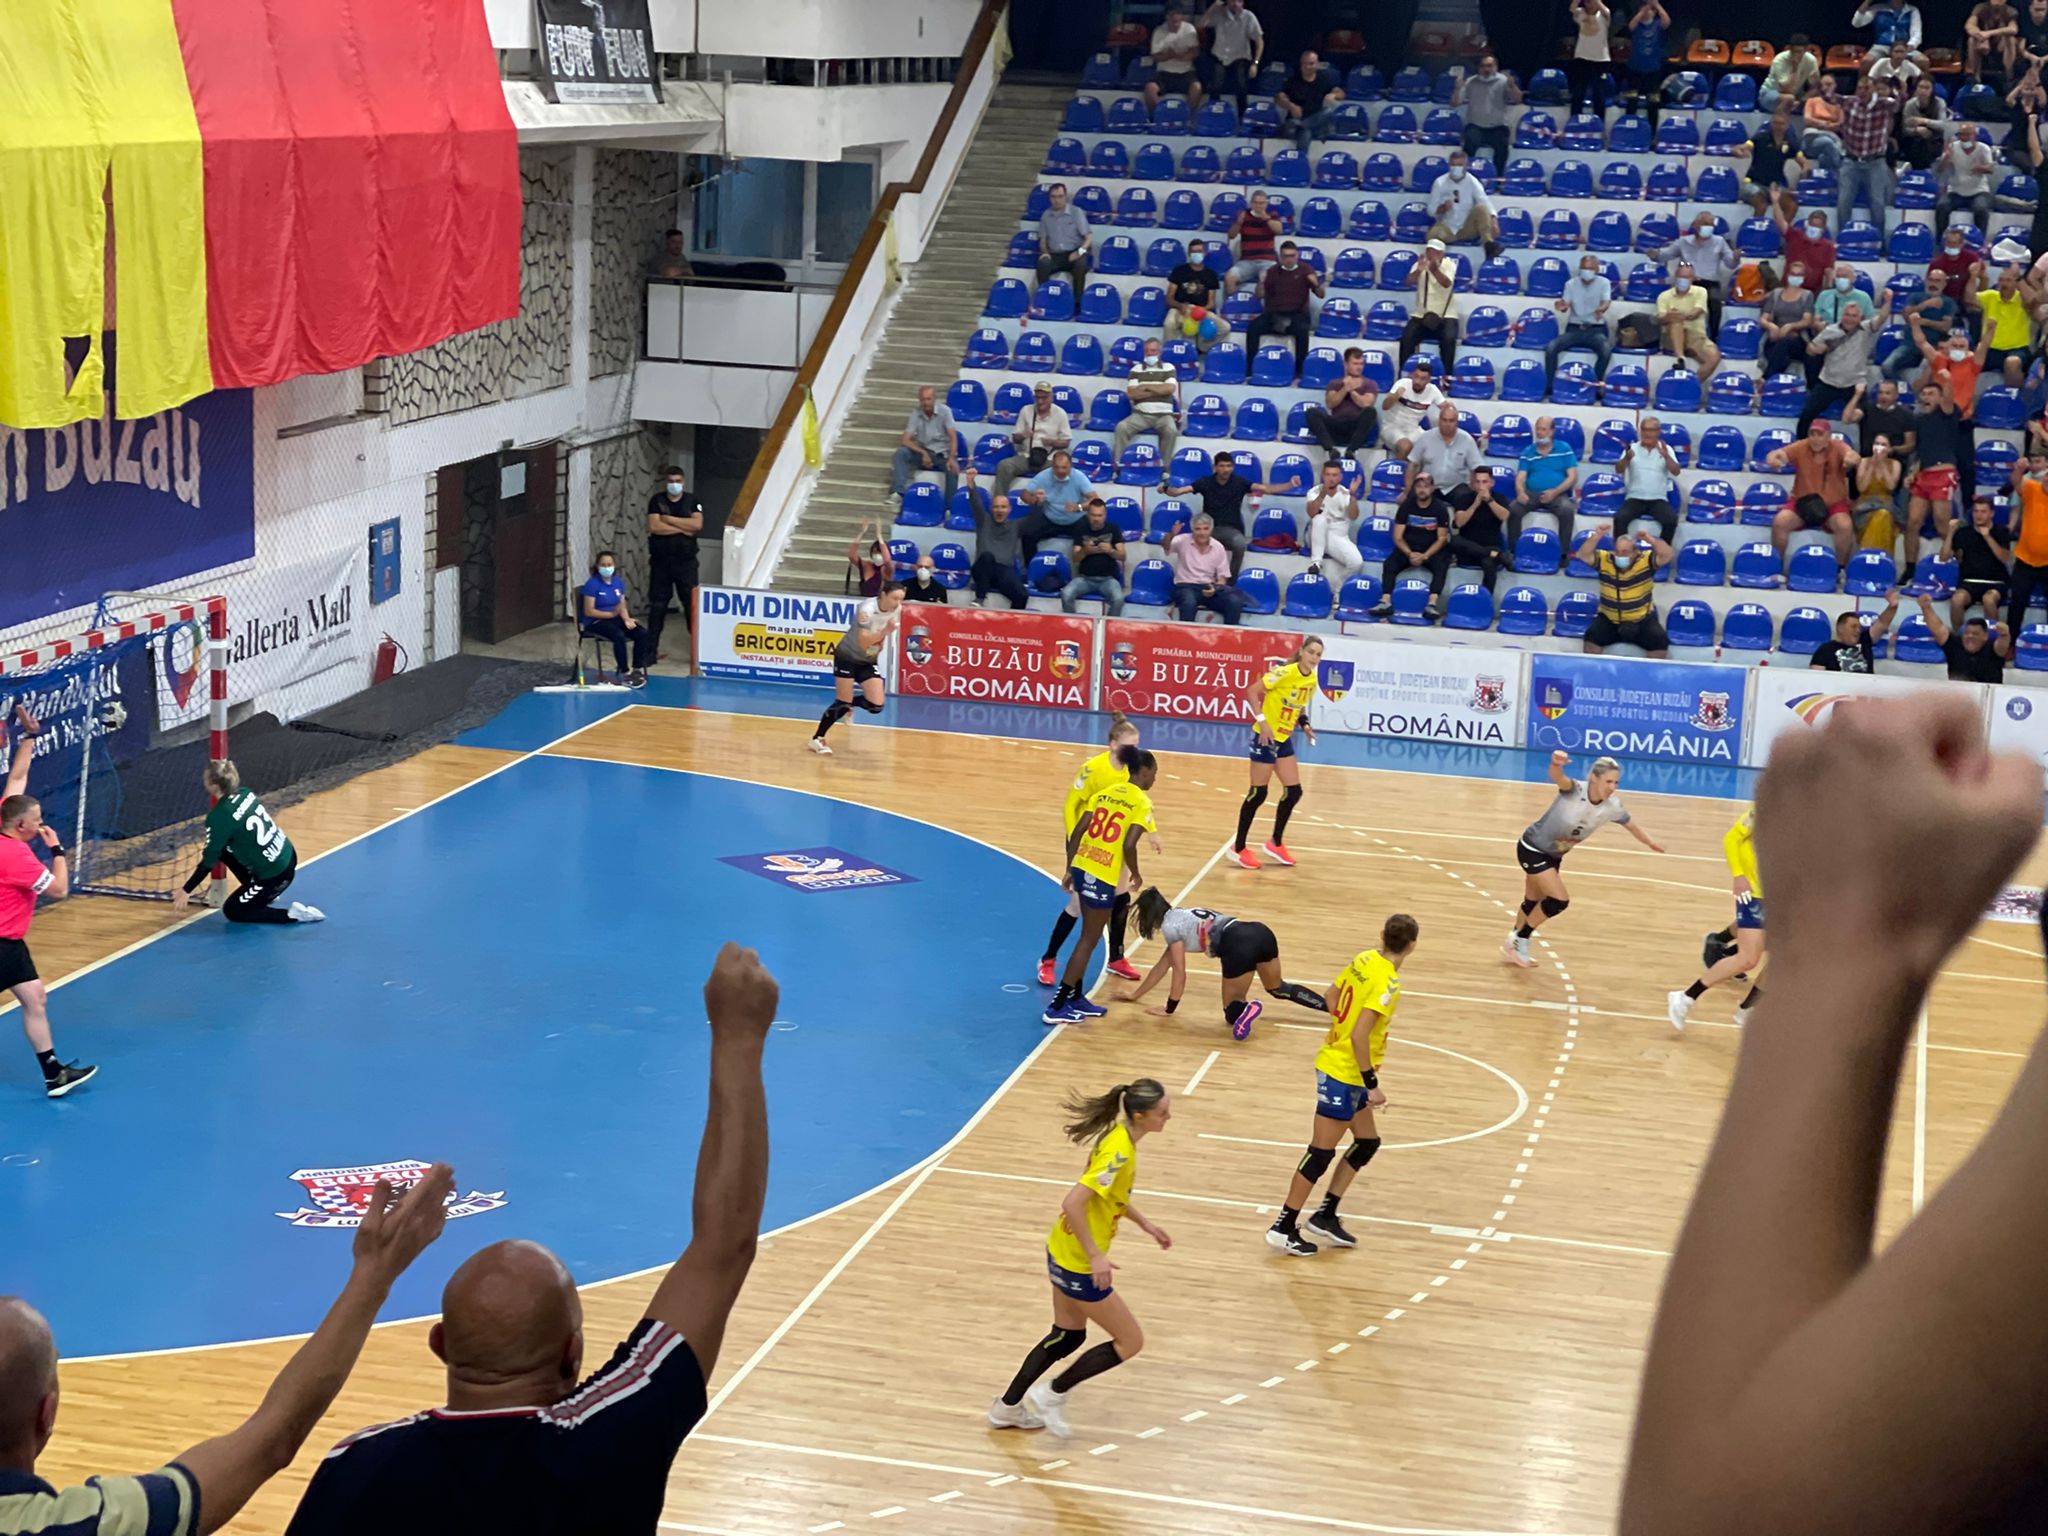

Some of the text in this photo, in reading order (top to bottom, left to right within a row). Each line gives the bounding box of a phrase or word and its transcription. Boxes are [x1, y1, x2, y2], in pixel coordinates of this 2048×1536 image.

[703, 591, 856, 625] IDM DINAM
[222, 585, 351, 664] alleria Mall
[767, 625, 813, 635] magazin
[735, 634, 837, 655] BRICOINSTA
[947, 645, 1043, 672] BUZĂU
[797, 658, 833, 667] BRICOLA
[1152, 662, 1250, 689] BUZĂU
[949, 675, 1084, 706] ROMÂNIA
[1153, 692, 1257, 720] ROMÂN
[1368, 713, 1504, 742] ROMÂNIA
[1584, 729, 1732, 759] ROMÂNIA
[1087, 807, 1126, 844] 86
[299, 1162, 422, 1179] HANDBAL CLUB
